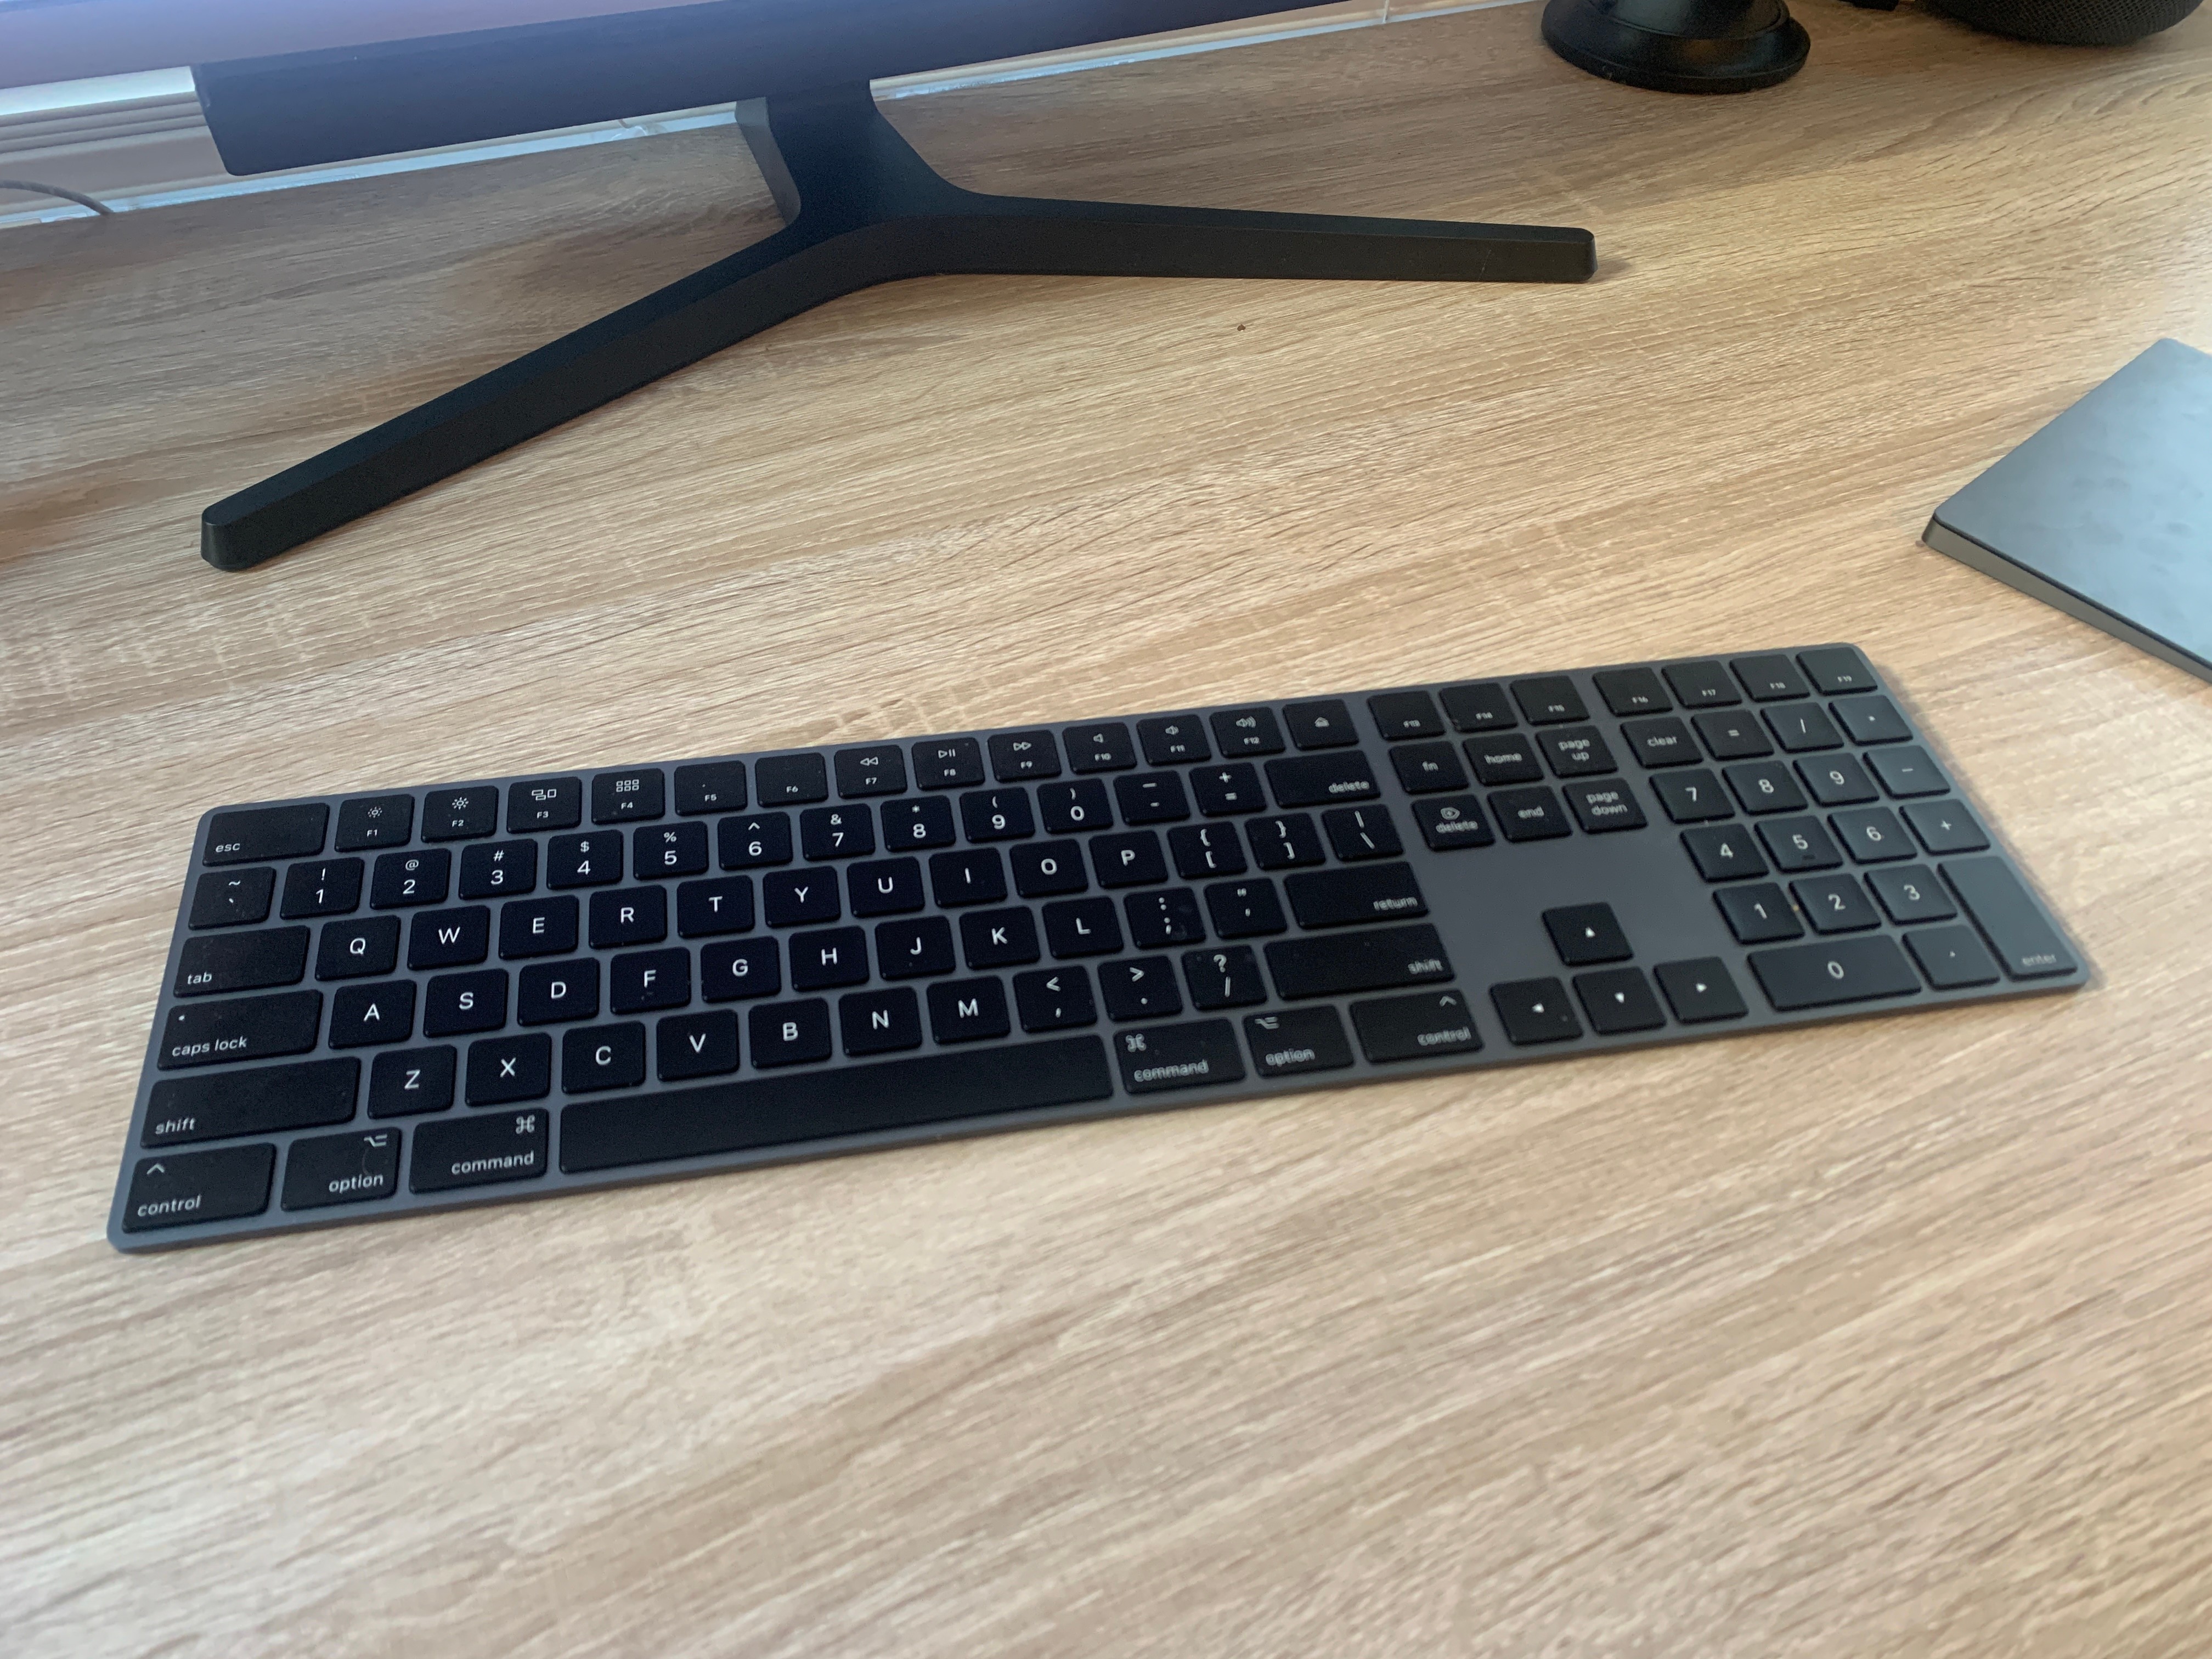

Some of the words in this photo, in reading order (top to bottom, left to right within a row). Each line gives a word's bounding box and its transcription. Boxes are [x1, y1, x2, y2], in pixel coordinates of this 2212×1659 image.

[1558, 739, 1590, 751] page
[1647, 736, 1677, 747] clear
[1484, 753, 1522, 764] home
[1571, 752, 1589, 761] up
[1020, 761, 1032, 769] F9
[1421, 761, 1438, 771] fn
[944, 769, 956, 777] F8
[1219, 772, 1231, 782] +
[1829, 771, 1844, 785] 9
[865, 777, 877, 785] F7
[1328, 781, 1370, 793] delete
[1758, 779, 1774, 793] 8
[1070, 788, 1076, 800] )
[1224, 792, 1237, 800] =
[1586, 791, 1619, 804] page
[1685, 787, 1697, 802] 7
[621, 802, 633, 810] F4
[992, 796, 998, 808] (
[1070, 805, 1085, 821] 0
[1517, 806, 1544, 819] end
[1591, 804, 1628, 816] down
[830, 814, 842, 825] &
[992, 814, 1006, 830] 9
[1436, 821, 1479, 833] delete
[663, 832, 677, 843] %
[913, 823, 926, 838] 8
[1866, 826, 1882, 841] 6
[580, 840, 590, 853] $
[832, 832, 844, 847] 7
[1792, 834, 1808, 850] 5
[215, 843, 240, 853] esc
[493, 850, 504, 861] #
[748, 841, 762, 856] 6
[1720, 843, 1734, 857] 4
[405, 859, 419, 871] @
[664, 850, 677, 865] 5
[1121, 849, 1135, 866] P
[577, 860, 591, 875] 4
[1041, 858, 1057, 874] O
[321, 868, 326, 881] !
[490, 870, 504, 885] 3
[964, 867, 971, 883] I
[402, 879, 416, 894] 2
[878, 877, 893, 893] U
[1903, 884, 1920, 900] 3
[315, 889, 324, 904] 1
[794, 887, 809, 903] Y
[1828, 894, 1846, 910] 2
[709, 896, 723, 912] T
[1373, 897, 1418, 910] return
[1754, 903, 1768, 919] 1
[620, 907, 634, 923] R
[532, 917, 545, 934] E
[1075, 918, 1090, 935] L
[438, 927, 460, 944] W
[991, 927, 1007, 945] K
[349, 938, 366, 955] Q
[910, 937, 922, 955] J
[821, 947, 838, 966] H
[1213, 954, 1227, 973] ?
[2022, 954, 2057, 966] enter
[732, 958, 748, 977] G
[1408, 959, 1443, 974] shift
[187, 972, 212, 985] tab
[644, 970, 656, 988] F
[551, 981, 567, 999] D
[459, 992, 473, 1010] S
[958, 998, 978, 1018] M
[363, 1003, 380, 1022] A
[872, 1009, 889, 1030] N
[782, 1022, 798, 1041] B
[1417, 1027, 1471, 1046] control
[172, 1043, 210, 1057] caps
[215, 1036, 247, 1051] lock
[689, 1034, 706, 1053] V
[595, 1046, 611, 1065] C
[1265, 1048, 1315, 1066] option
[500, 1057, 516, 1077] X
[1133, 1059, 1209, 1082] command
[404, 1069, 420, 1090] Z
[155, 1118, 195, 1135] shift
[451, 1150, 534, 1175] command
[329, 1174, 383, 1193] option
[137, 1195, 201, 1217] control
